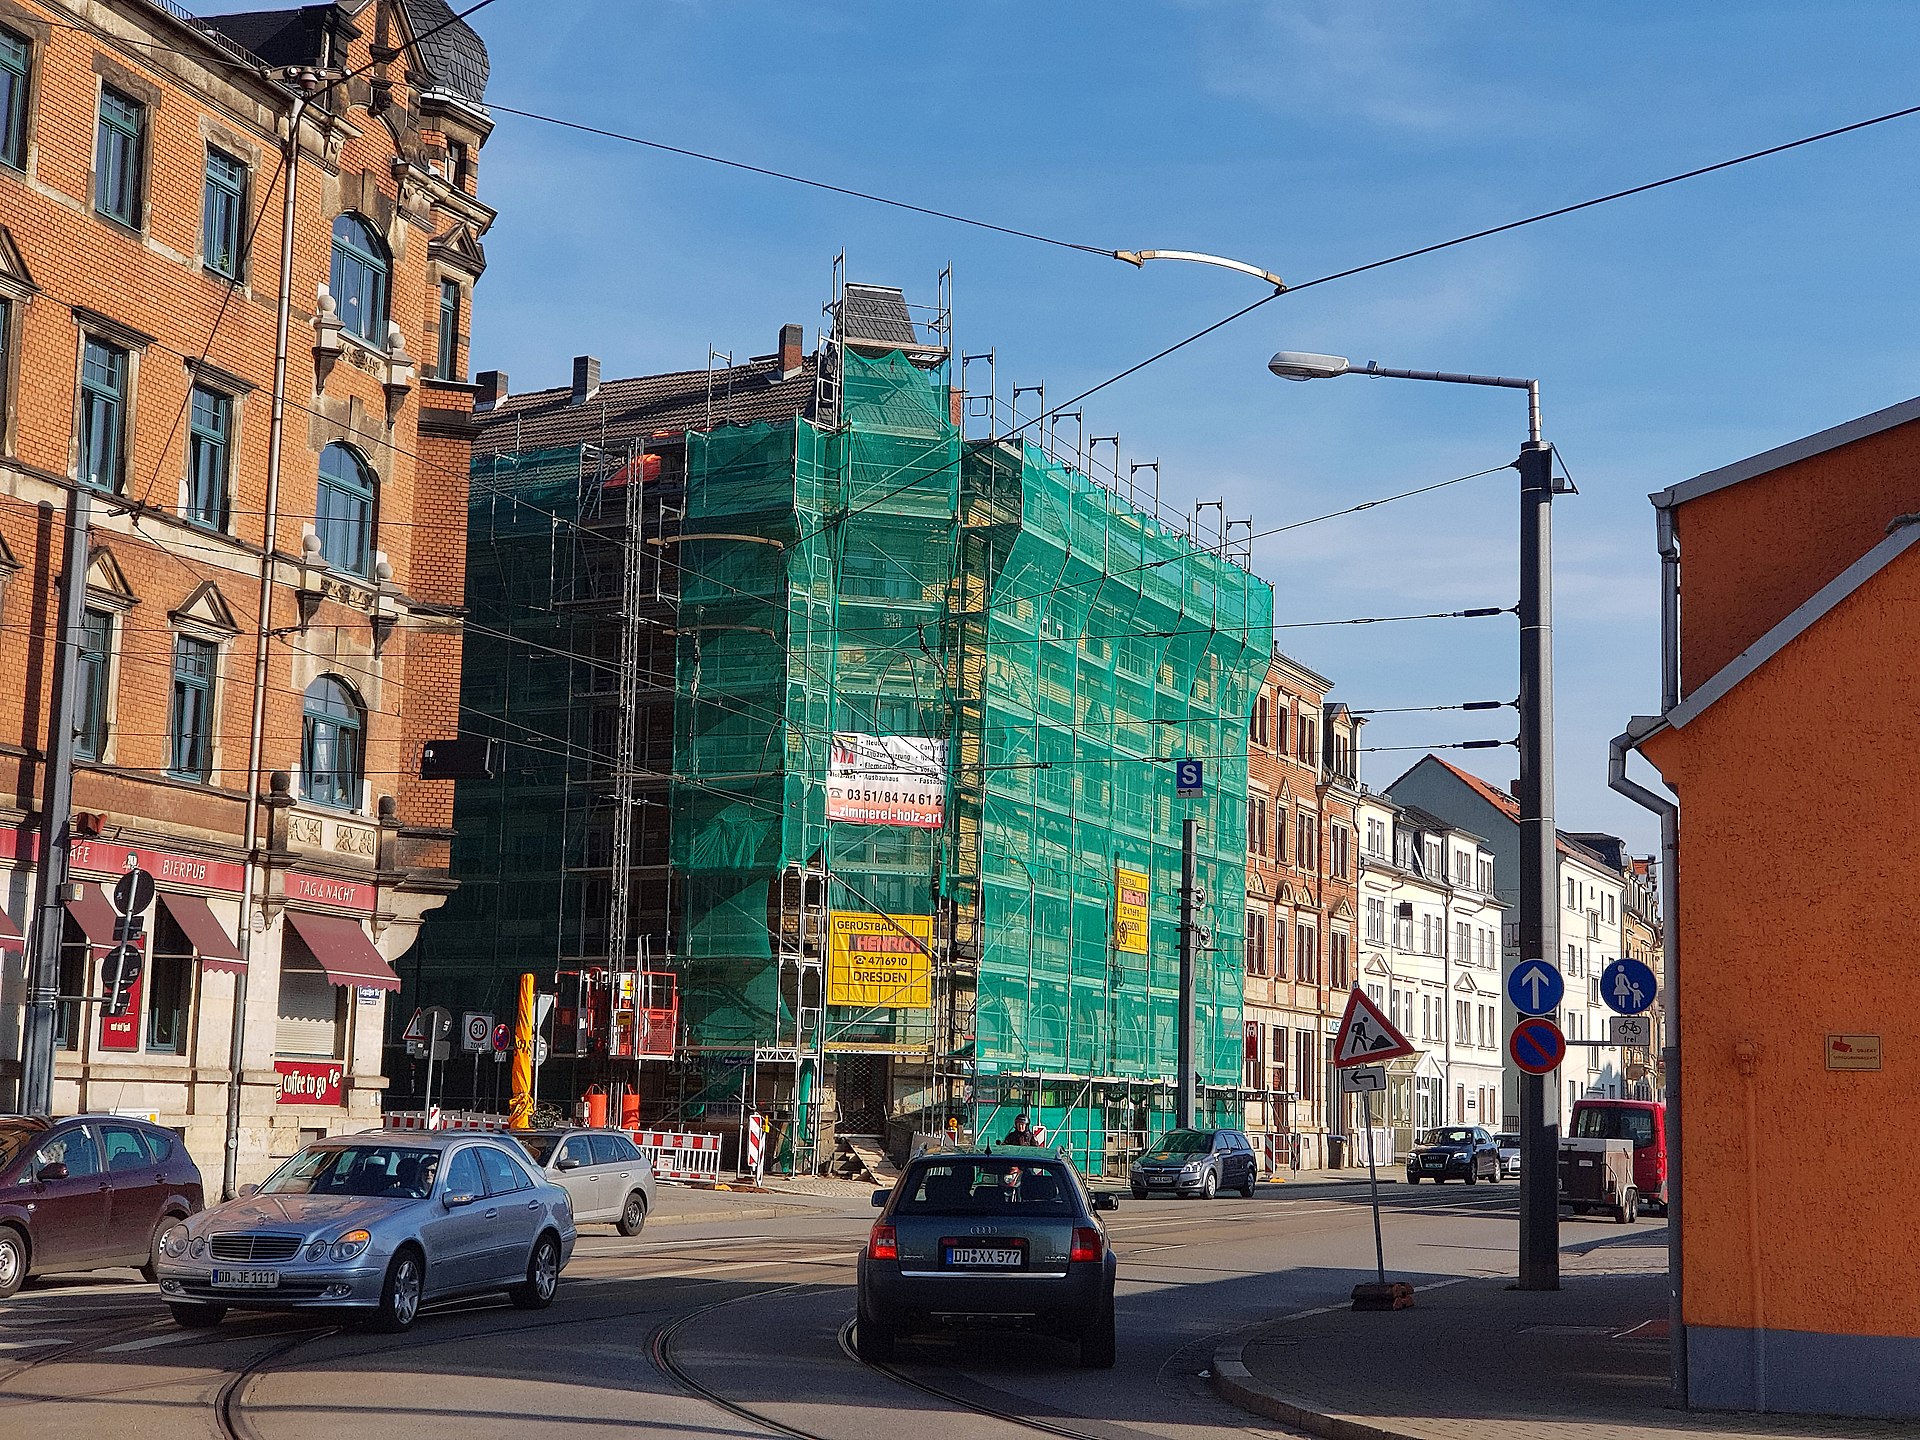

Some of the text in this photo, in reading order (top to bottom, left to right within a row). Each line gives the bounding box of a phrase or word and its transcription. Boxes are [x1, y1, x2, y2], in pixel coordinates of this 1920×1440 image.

[1182, 764, 1197, 785] S
[847, 789, 860, 801] 03
[864, 790, 899, 803] 51/84
[902, 792, 915, 804] 74
[918, 793, 931, 805] 61
[70, 844, 90, 863] AFE
[162, 859, 206, 880] BIERPUB
[299, 880, 356, 903] TAG & NACHT
[837, 920, 895, 932] GERÜSTBAU
[868, 956, 908, 966] 4716910
[853, 971, 907, 983] DRESDEN
[473, 1024, 484, 1035] 30
[283, 1070, 305, 1095] coffee
[306, 1073, 315, 1094] to
[315, 1076, 327, 1100] go
[954, 1250, 1020, 1264] DD XX 577
[218, 1271, 276, 1284] DD JE 1111
